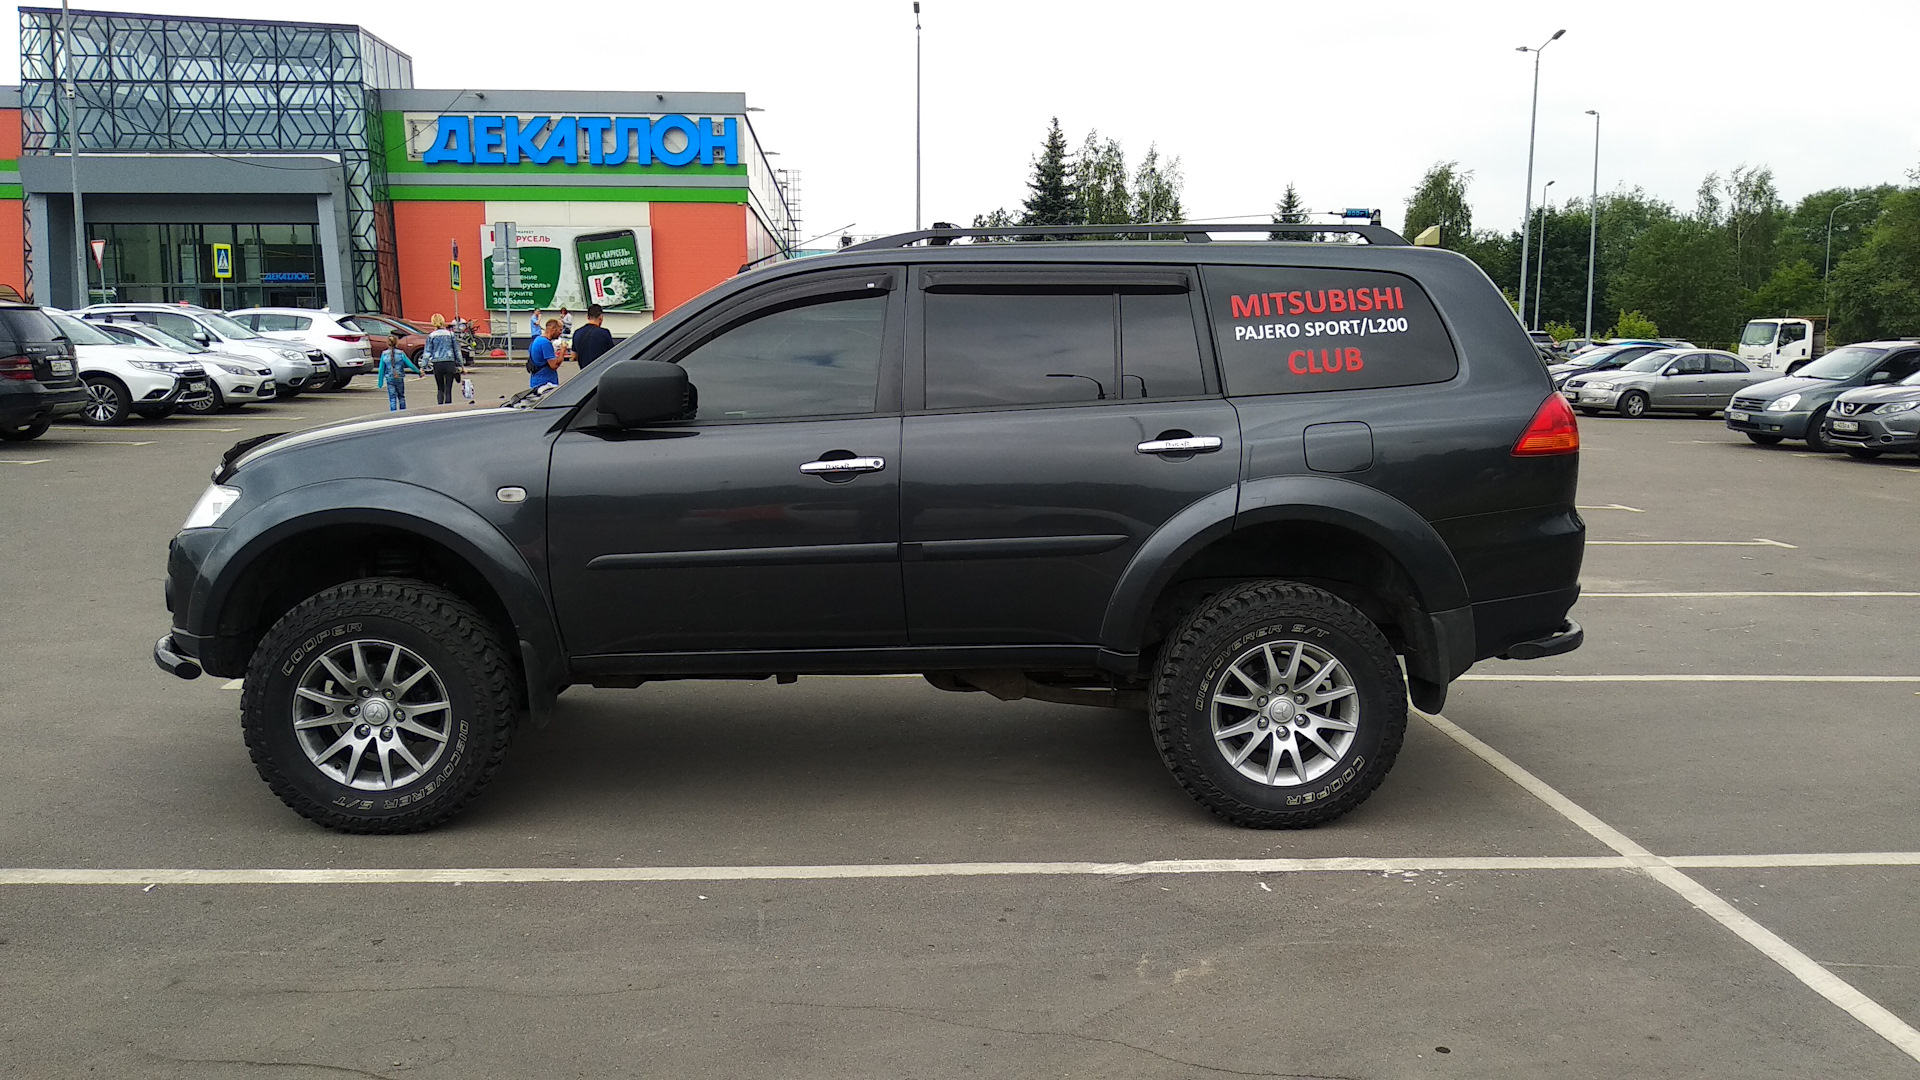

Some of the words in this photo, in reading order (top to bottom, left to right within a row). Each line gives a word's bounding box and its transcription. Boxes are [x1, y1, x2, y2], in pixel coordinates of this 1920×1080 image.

[423, 114, 738, 166] ДЕКАТЛОН
[516, 235, 551, 243] РУСЕЛЬ
[585, 252, 601, 261] КАРТА
[1230, 286, 1404, 318] MITSUBISHI
[1235, 322, 1300, 341] PAJERO
[1304, 317, 1408, 337] SPORT/L200
[1288, 347, 1364, 375] CLUB
[281, 622, 363, 677] COOPER
[1195, 624, 1283, 711] DISCOVERER
[1291, 624, 1330, 638] S/T
[383, 720, 469, 810] DISCOVERER
[1286, 754, 1366, 806] COOPER
[332, 796, 374, 810] S/T
